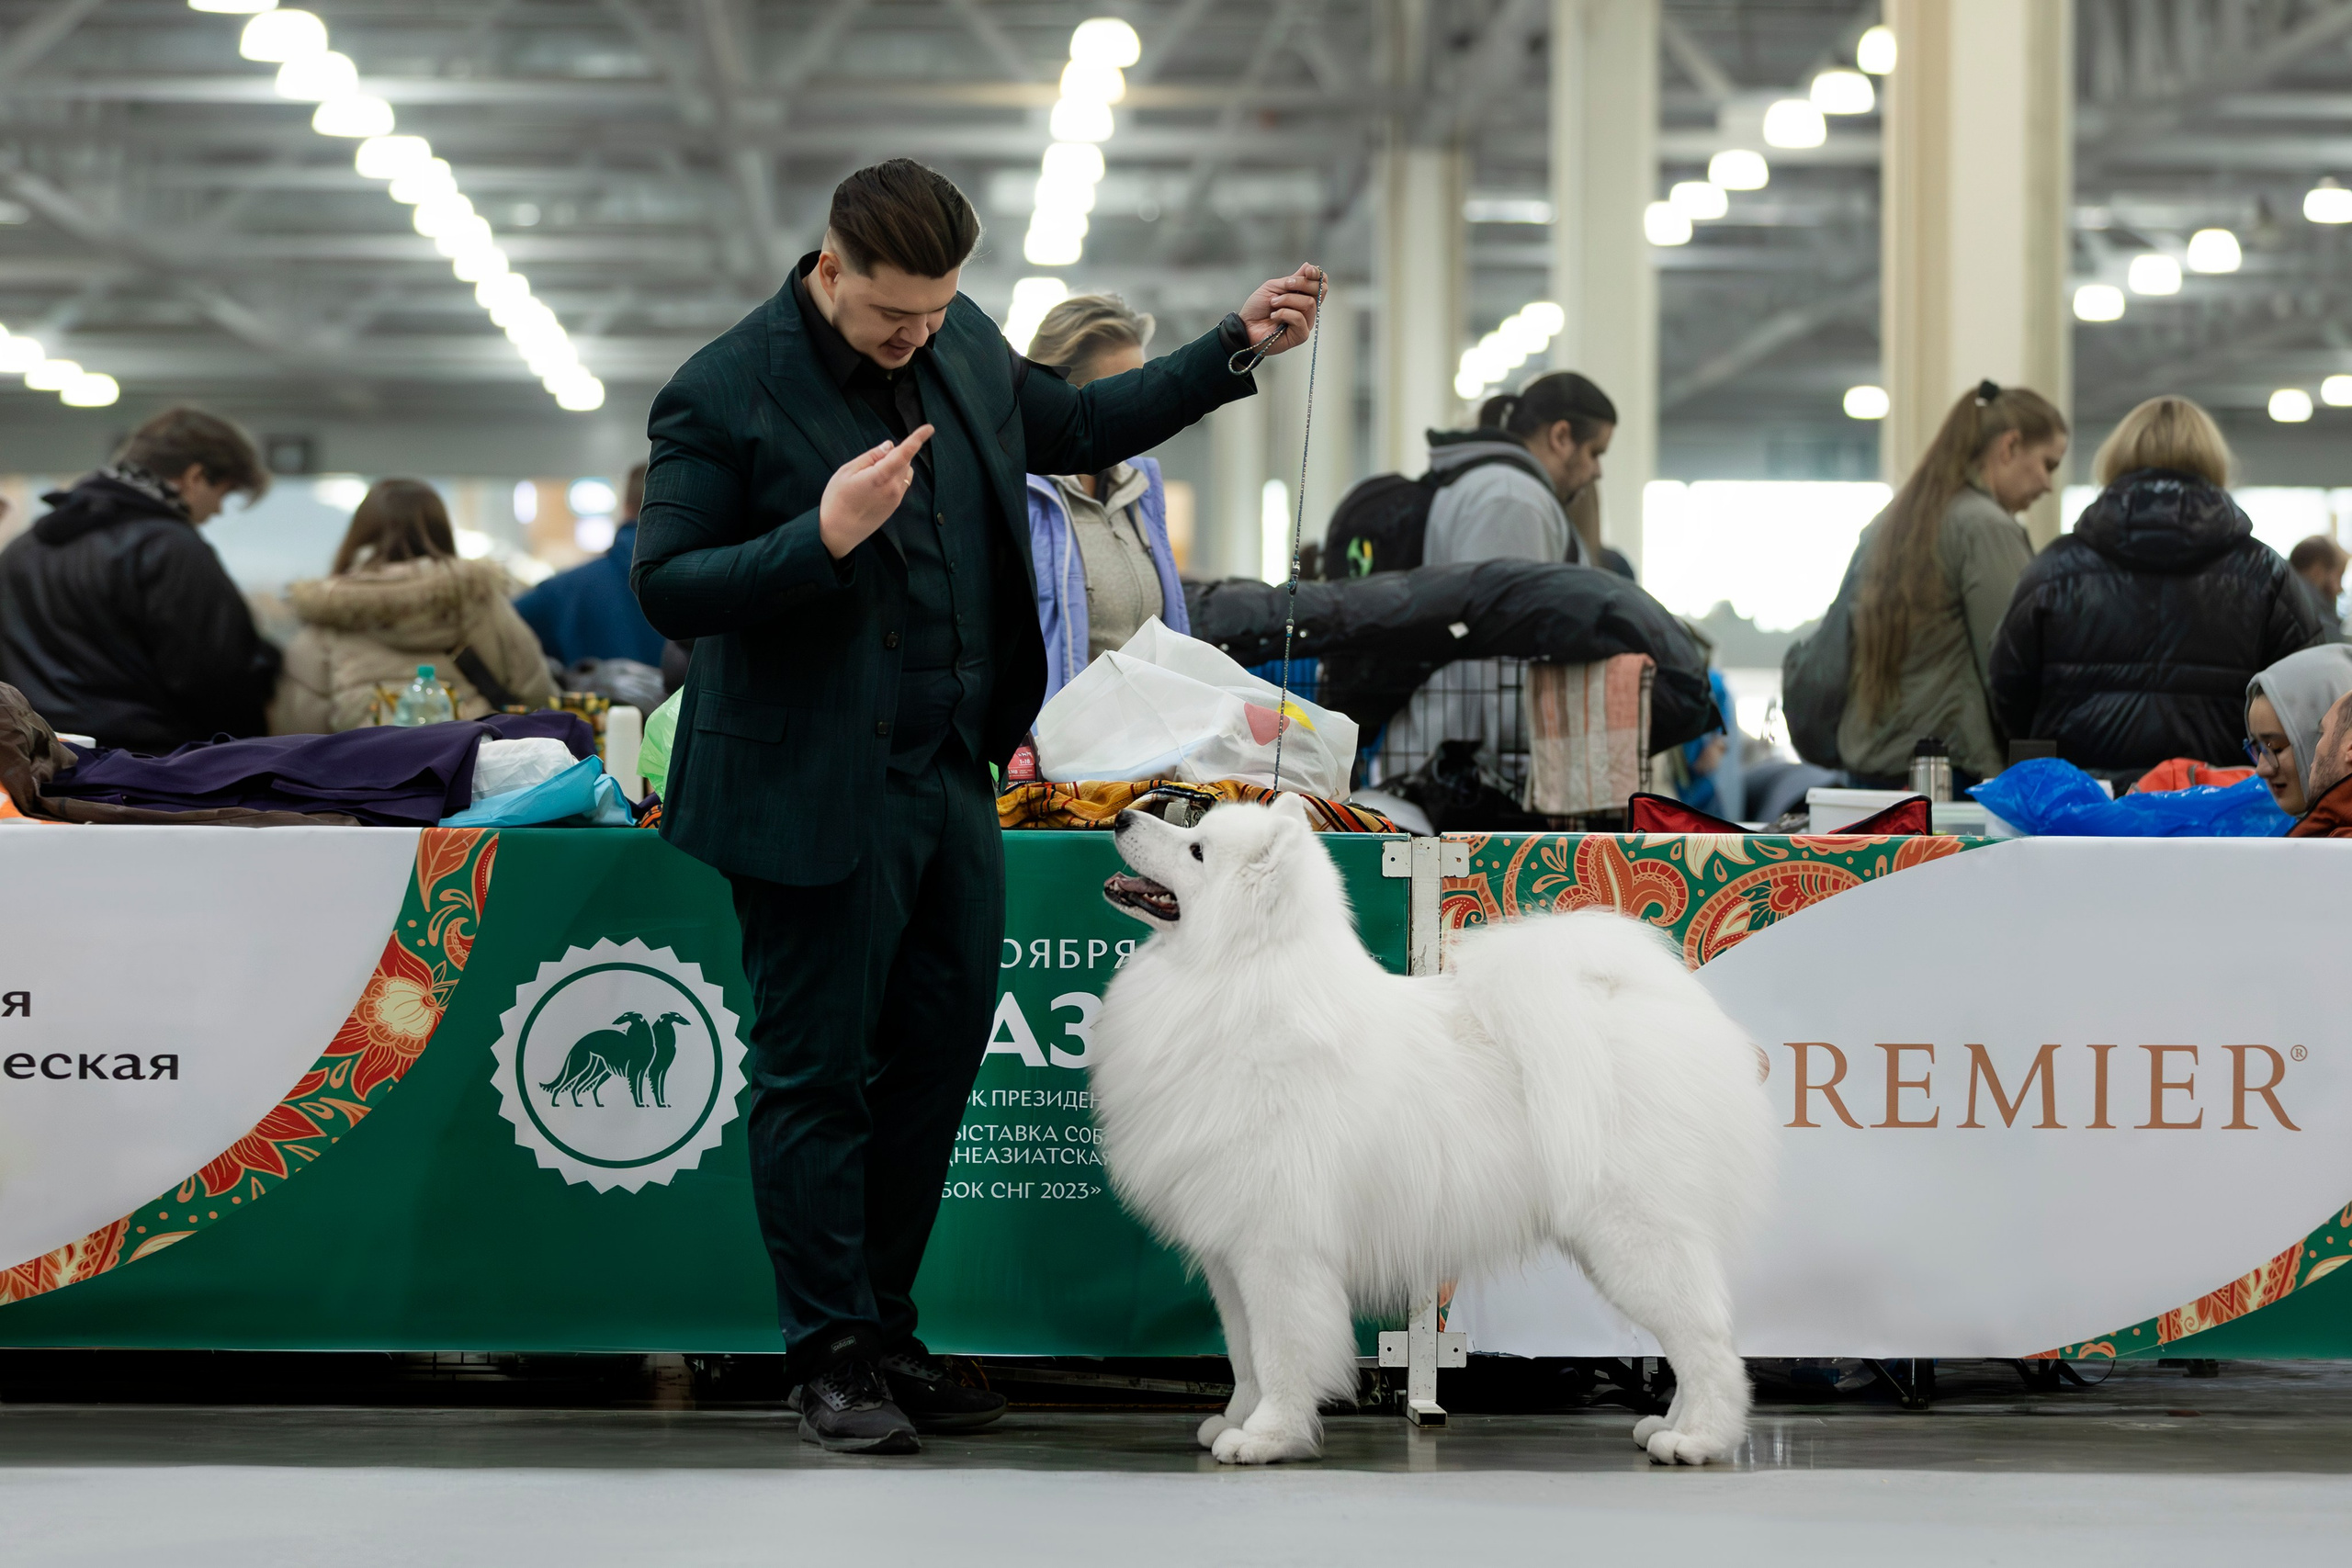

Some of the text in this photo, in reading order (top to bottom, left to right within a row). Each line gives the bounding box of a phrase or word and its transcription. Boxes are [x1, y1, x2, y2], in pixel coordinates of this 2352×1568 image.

[1000, 938, 1136, 969] ОЯБРЯ
[1, 991, 30, 1017] я
[980, 991, 1103, 1069] АЗ
[3, 1053, 179, 1080] еская
[967, 1089, 988, 1107] К
[1748, 1042, 2308, 1132] REMIER®
[1064, 1125, 1102, 1145] СОБ
[942, 1181, 1102, 1200] БОК СНГ 2023»
